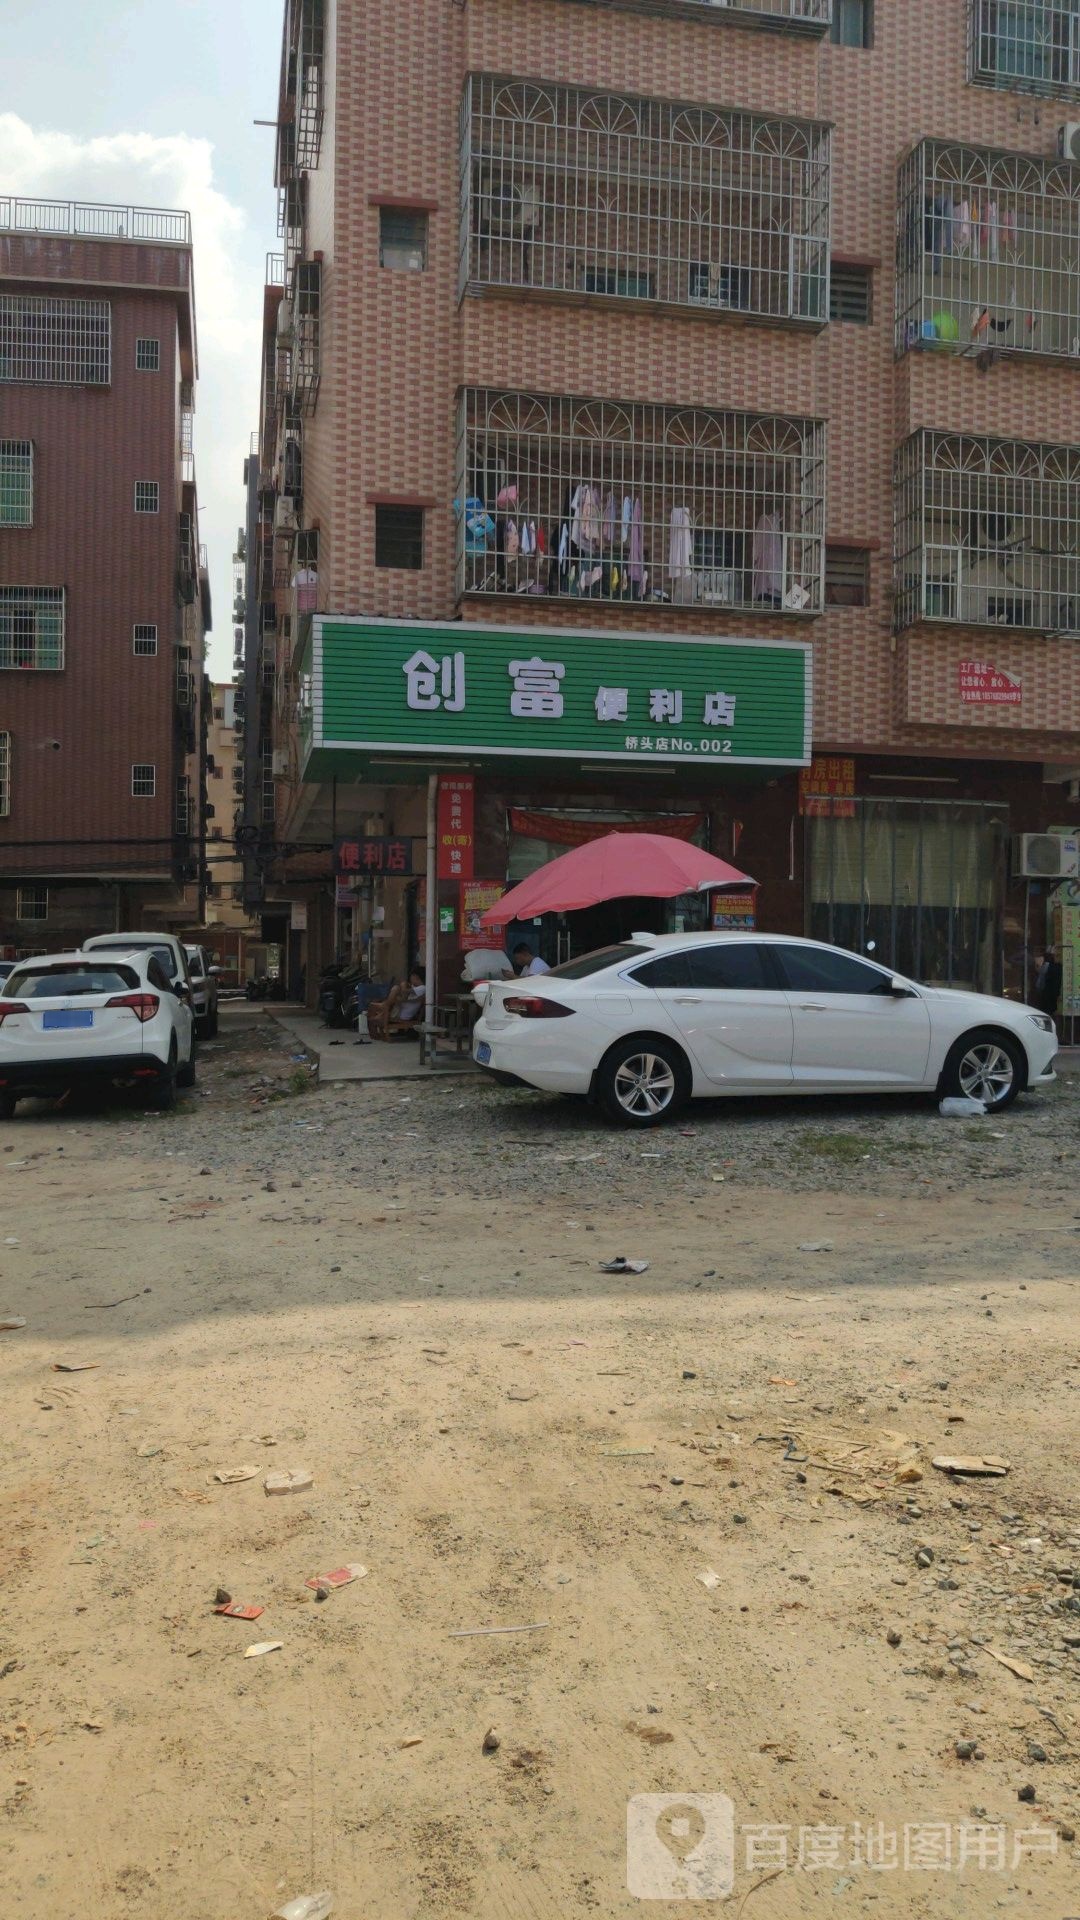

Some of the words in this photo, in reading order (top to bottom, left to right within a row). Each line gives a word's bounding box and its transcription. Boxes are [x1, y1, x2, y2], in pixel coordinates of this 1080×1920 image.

[402, 650, 736, 727] 创富便利店
[625, 736, 732, 753] 桥头店No.002
[339, 841, 407, 870] 便利店
